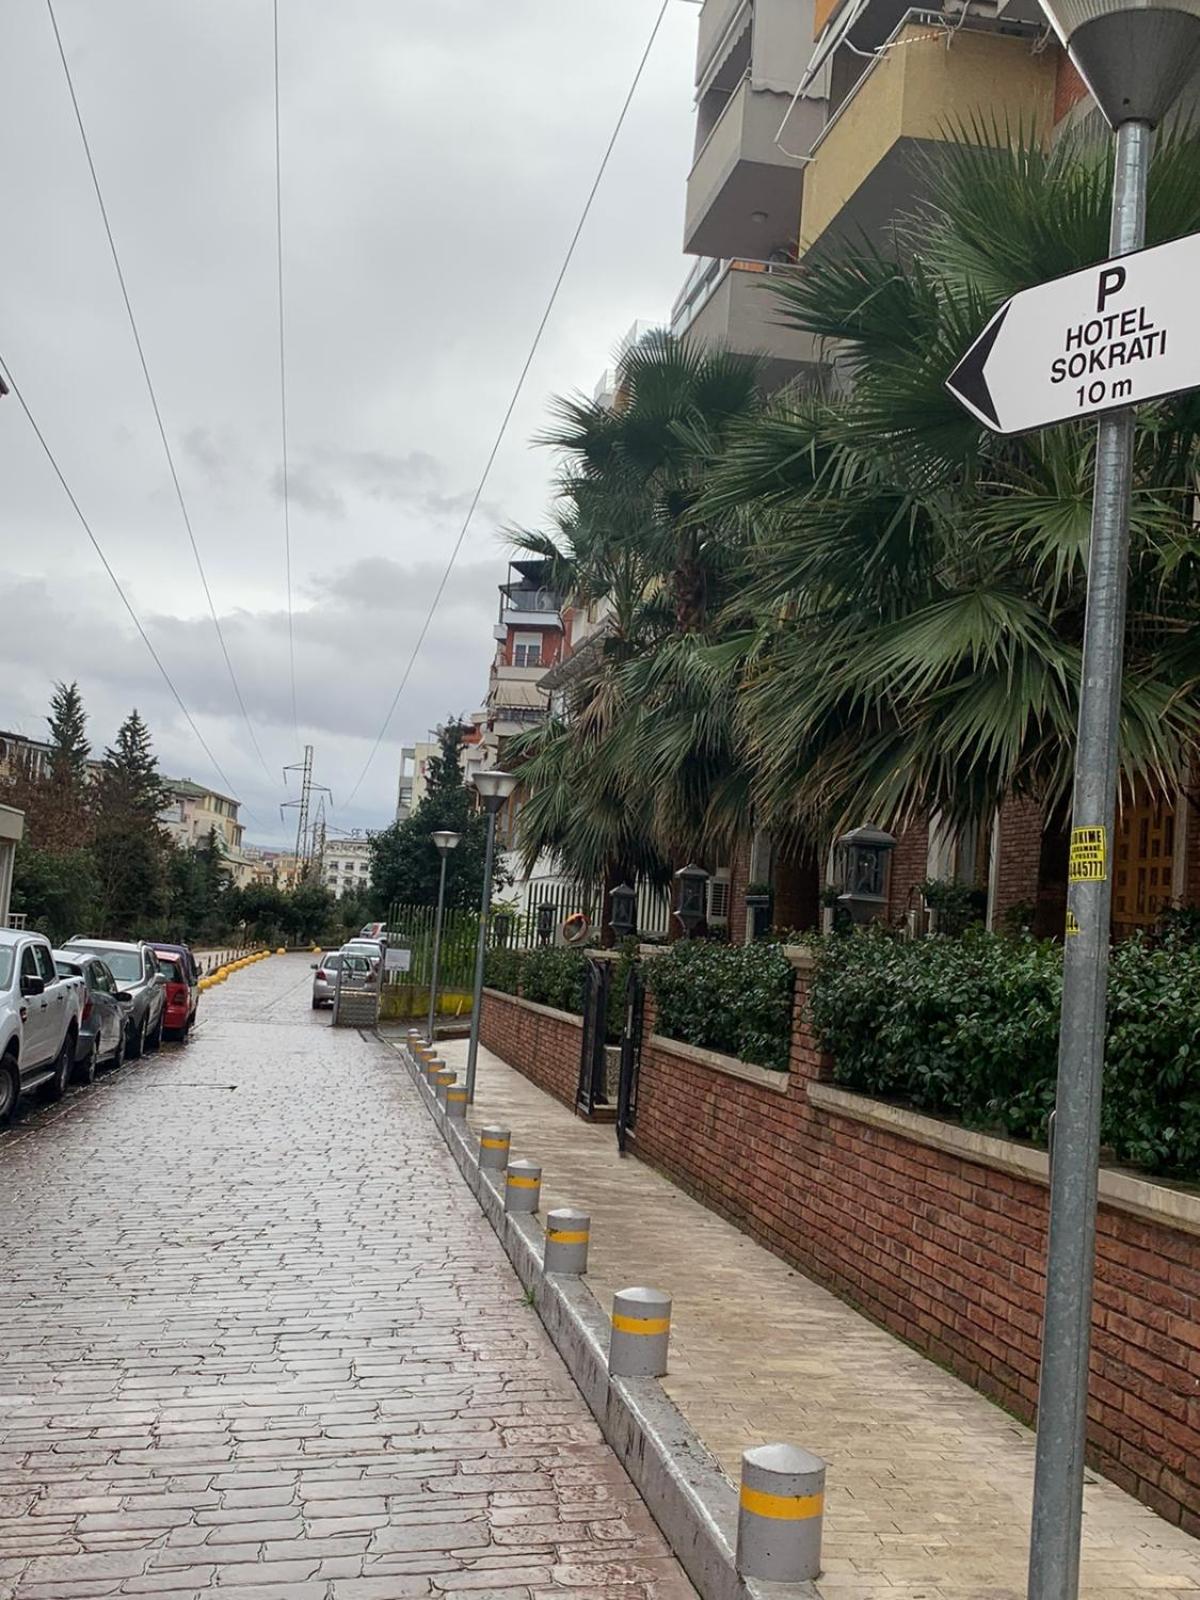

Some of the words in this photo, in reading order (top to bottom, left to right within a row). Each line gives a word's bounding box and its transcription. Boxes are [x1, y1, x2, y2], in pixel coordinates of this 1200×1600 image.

[1097, 266, 1126, 313] P
[1066, 306, 1154, 351] HOTEL
[1050, 330, 1166, 384] SOKRATI
[1076, 380, 1106, 407] 10
[1111, 378, 1132, 399] m
